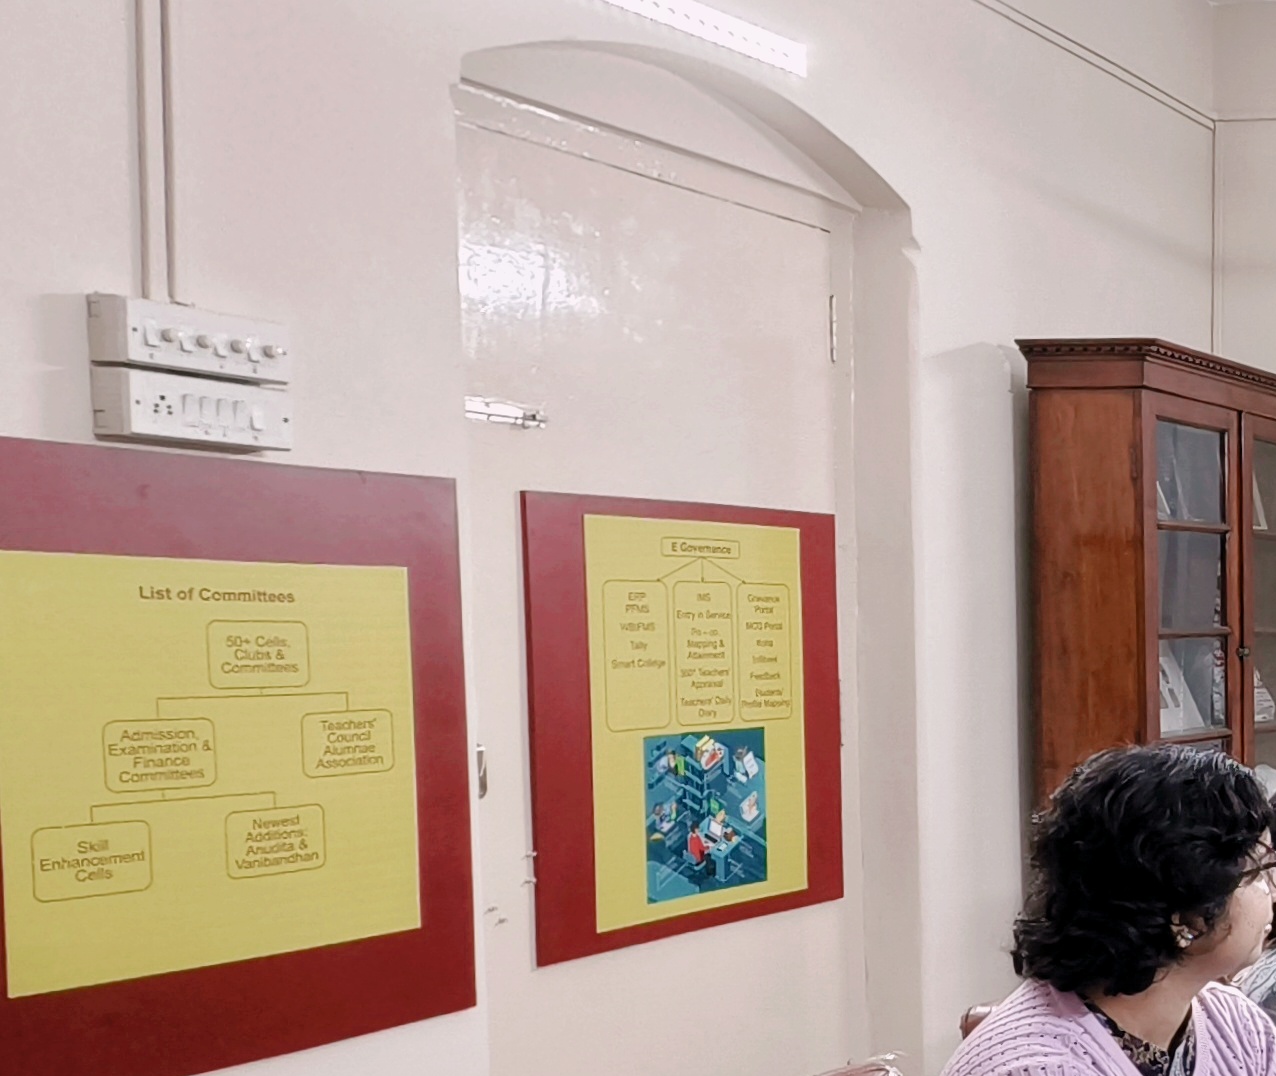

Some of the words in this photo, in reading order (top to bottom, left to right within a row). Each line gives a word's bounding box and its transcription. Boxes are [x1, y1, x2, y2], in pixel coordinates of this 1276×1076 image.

[671, 542, 677, 552] E
[680, 542, 731, 554] Governance
[139, 586, 171, 600] List
[177, 587, 194, 600] of
[199, 587, 295, 602] Committees
[226, 635, 250, 647] 50+
[234, 649, 272, 660] Clubs
[276, 649, 285, 660] &
[221, 662, 299, 674] Committees
[327, 731, 371, 744] Council
[108, 743, 197, 756] Examination
[202, 740, 213, 752] &
[323, 743, 376, 756] Alumnae
[133, 756, 190, 768] Finance
[315, 754, 384, 769] Association
[119, 769, 205, 783] Committees
[77, 839, 109, 854] Skill
[299, 838, 308, 851] &
[40, 850, 144, 871] Enhancement
[74, 867, 112, 882] Cells
